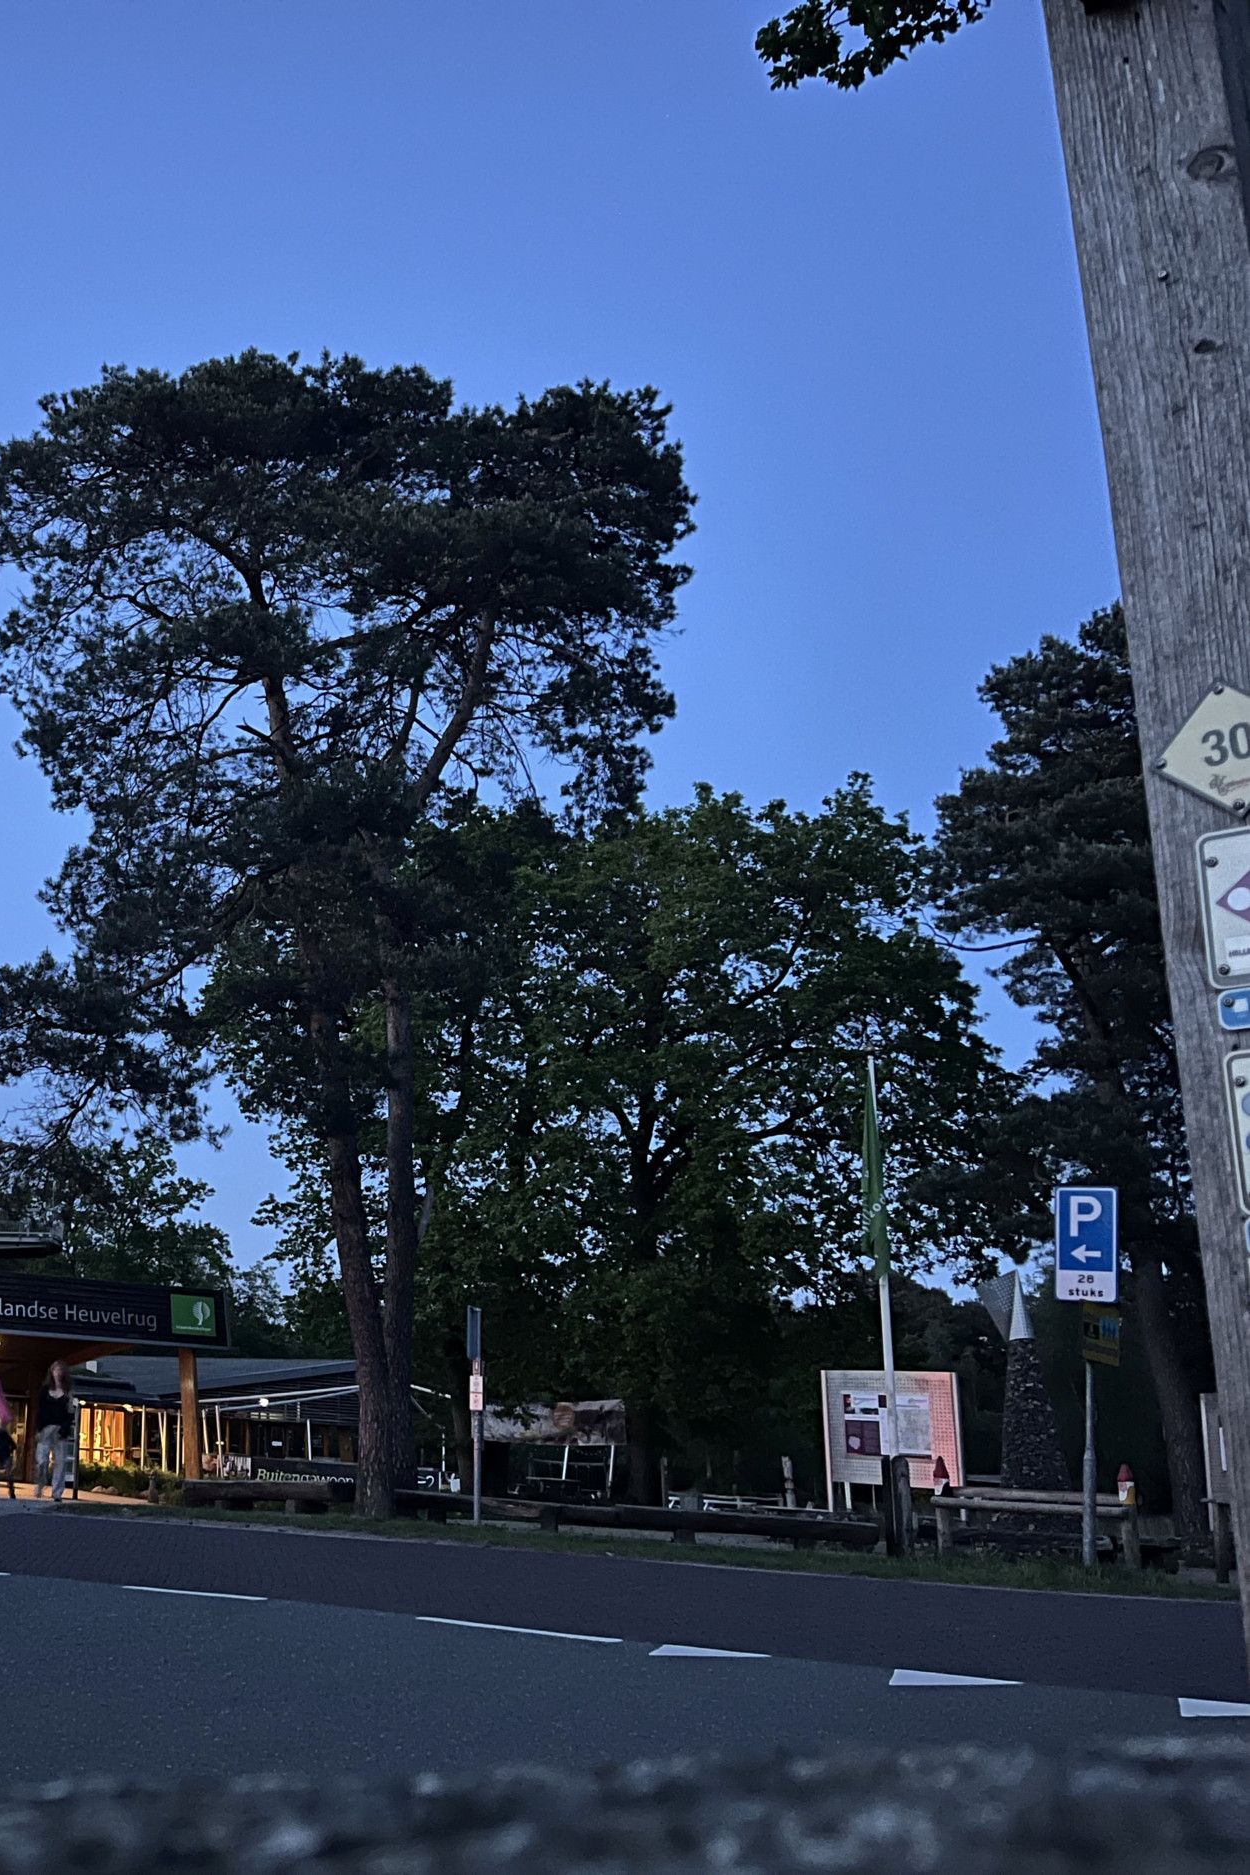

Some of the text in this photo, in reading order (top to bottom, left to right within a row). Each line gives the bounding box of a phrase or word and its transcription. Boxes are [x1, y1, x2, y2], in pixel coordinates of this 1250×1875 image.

[1201, 722, 1250, 767] 30
[1069, 1195, 1102, 1238] P
[1068, 1287, 1104, 1298] stuks
[64, 1303, 157, 1332] Heuvelrug
